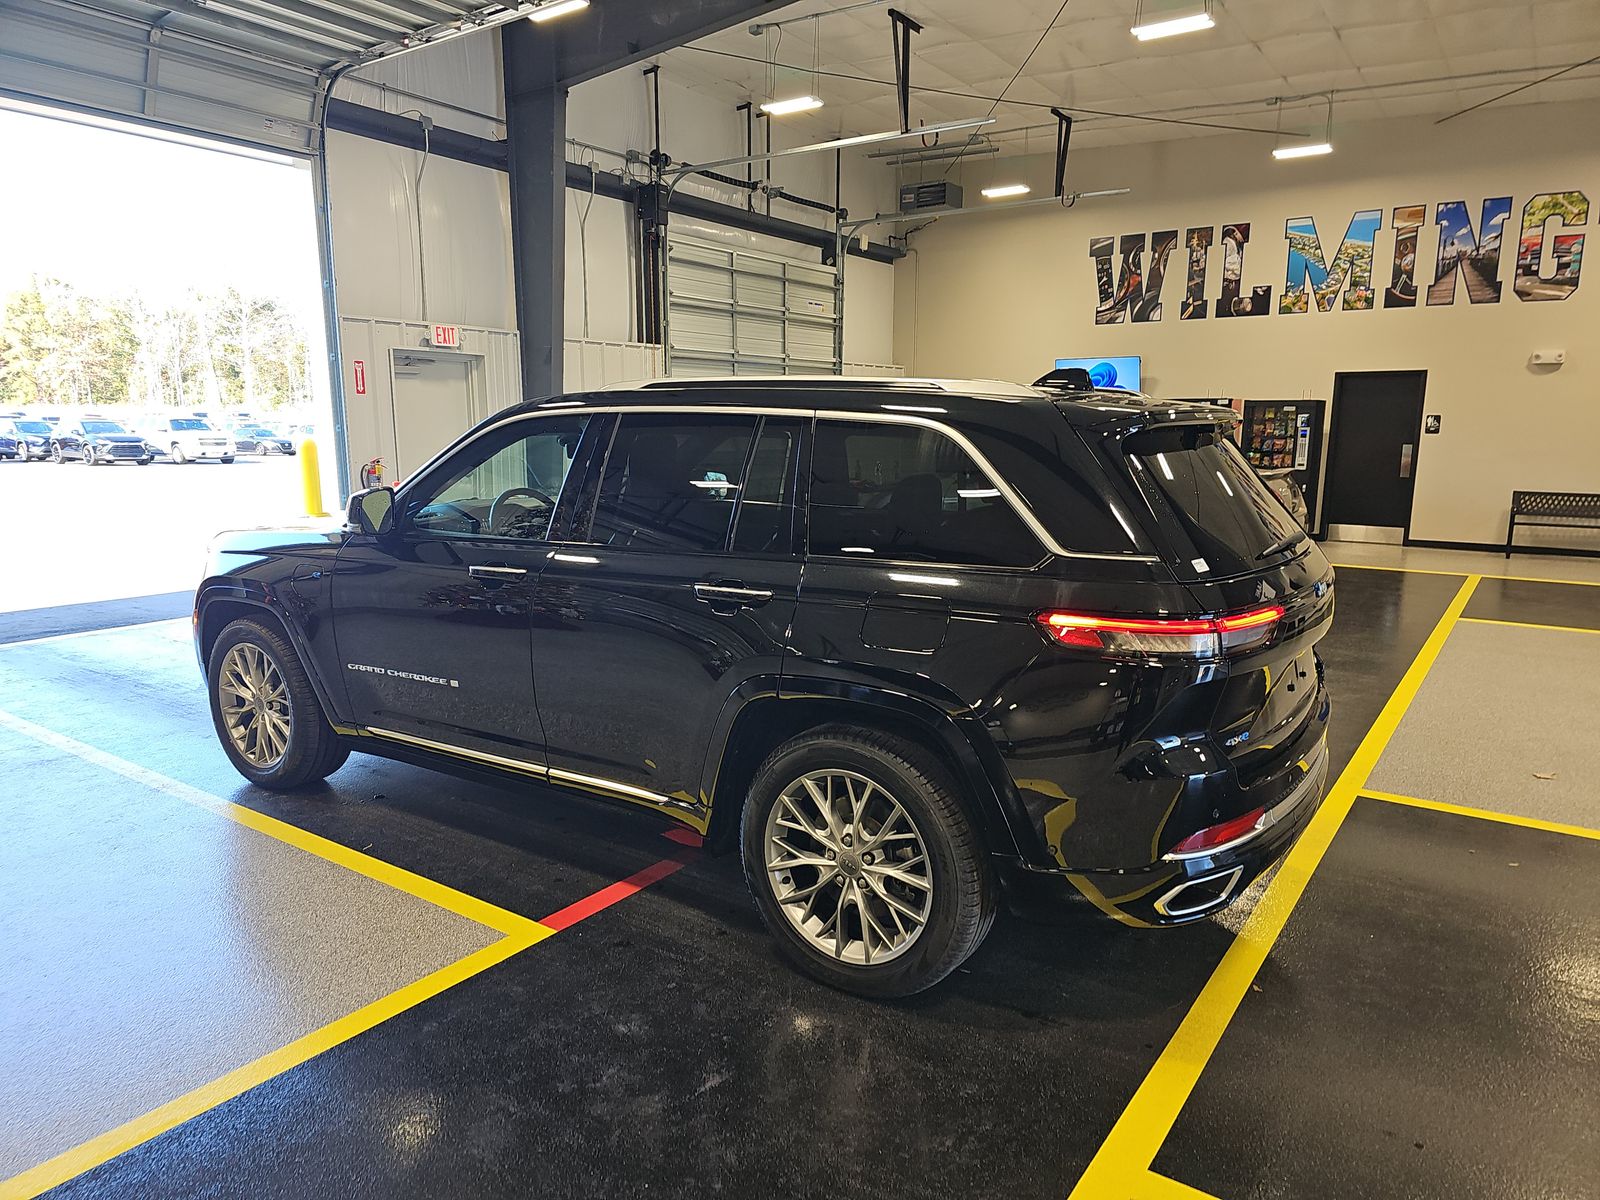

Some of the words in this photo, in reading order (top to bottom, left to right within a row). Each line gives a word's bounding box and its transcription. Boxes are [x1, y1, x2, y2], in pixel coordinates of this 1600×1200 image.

[1090, 190, 1600, 325] WILMING
[435, 326, 455, 345] EXIT
[347, 663, 385, 675] GRAND
[387, 669, 448, 685] CHEROKEE
